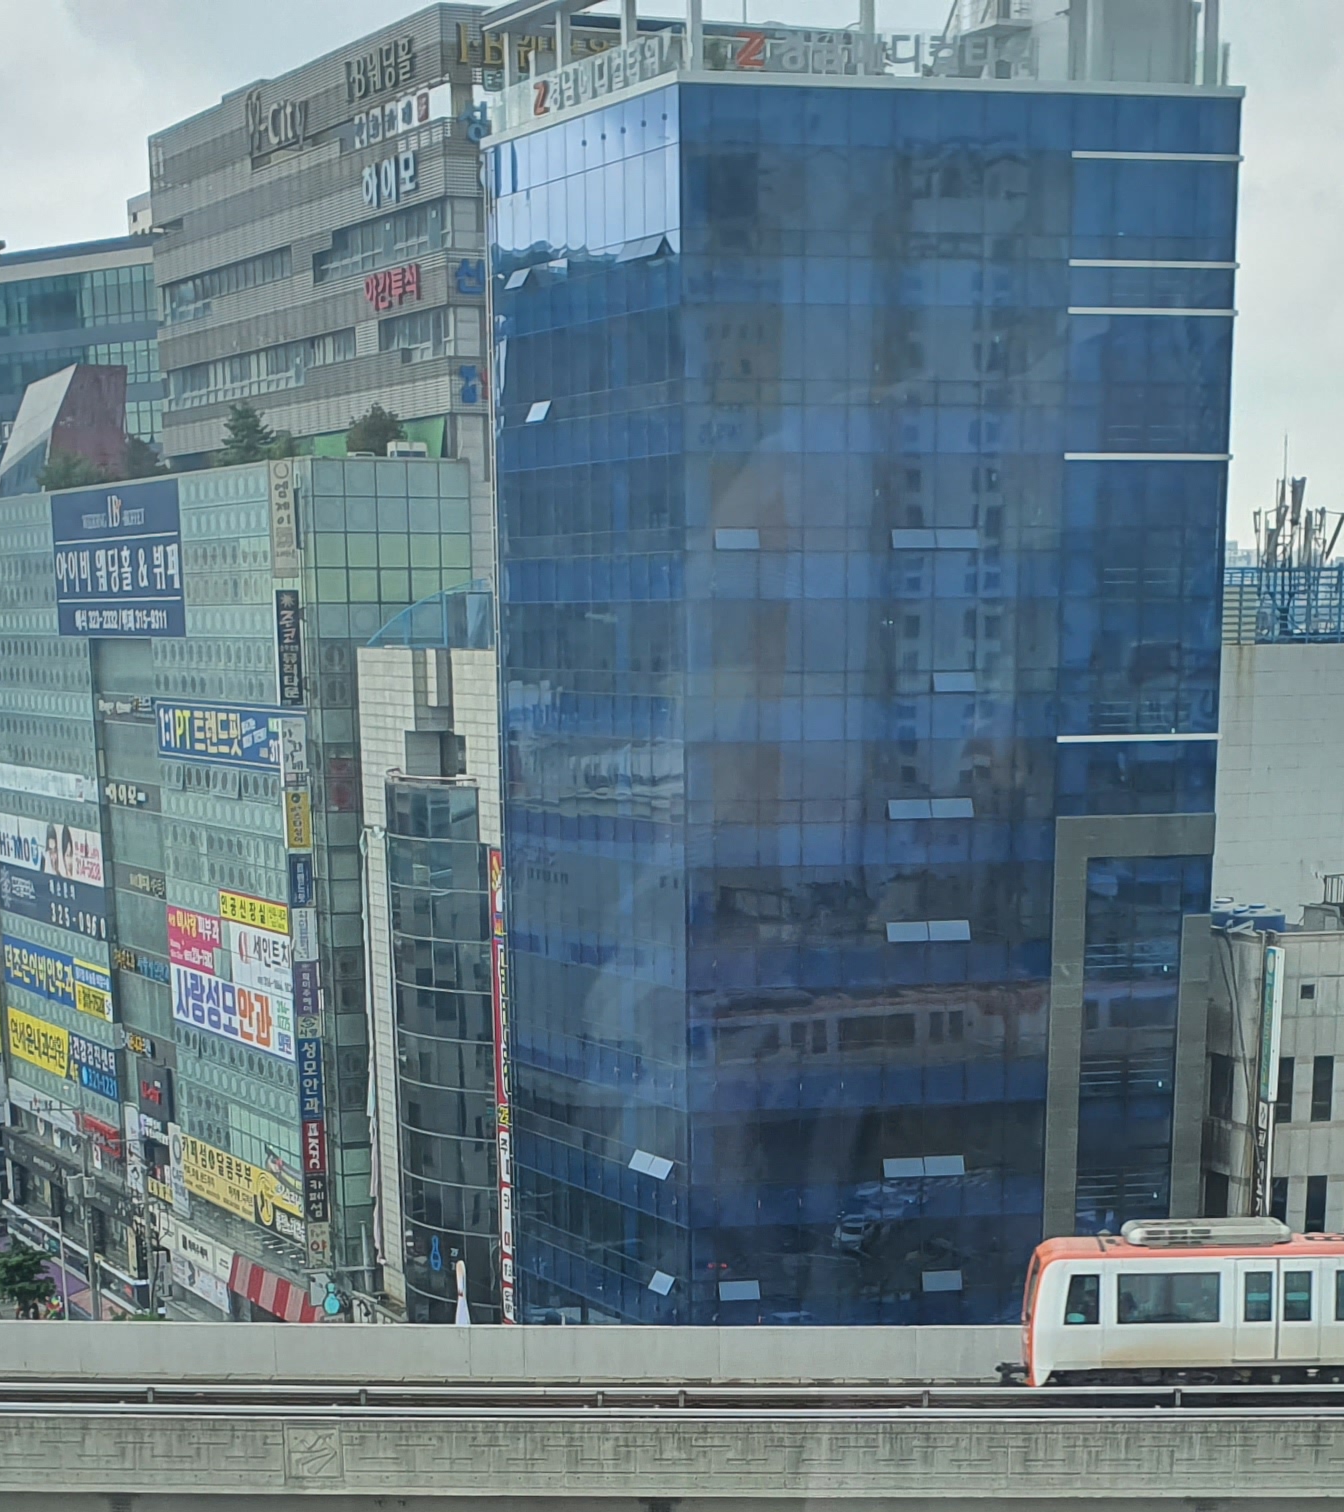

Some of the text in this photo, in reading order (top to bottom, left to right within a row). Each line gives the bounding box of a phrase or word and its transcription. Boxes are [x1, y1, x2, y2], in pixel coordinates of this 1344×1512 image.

[361, 151, 417, 208] 하이모
[56, 543, 181, 593] 아이비 웨딩홀 & 뷔페
[193, 710, 243, 757] 트렌드핏
[220, 894, 267, 925] 인공신장실
[198, 915, 221, 945] 피부과
[301, 1041, 319, 1114] 성모안과
[215, 1153, 253, 1190] 달콤부부
[308, 1138, 320, 1170] KFC
[309, 1180, 324, 1217] 카페섬
